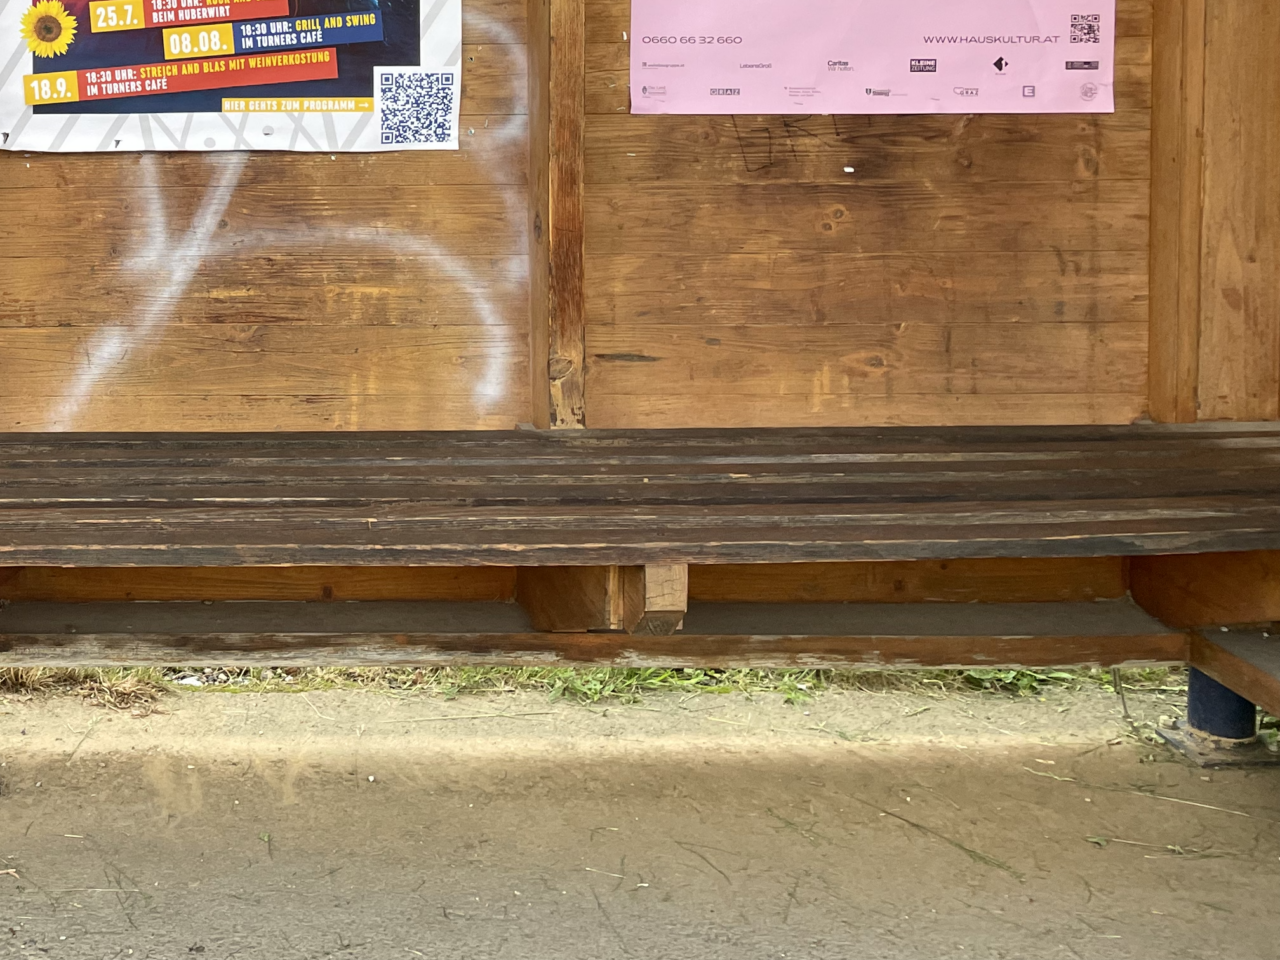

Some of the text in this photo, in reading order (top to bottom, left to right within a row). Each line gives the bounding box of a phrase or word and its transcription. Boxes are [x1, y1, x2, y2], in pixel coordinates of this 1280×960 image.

[96, 4, 138, 28] 25.7.
[170, 30, 227, 55] 08.08.
[642, 36, 743, 44] 0660 66 32 660
[923, 35, 1061, 44] WWW.HAUSKULTUR.AT
[30, 77, 71, 100] 18.9.
[224, 100, 355, 111] HIER GEHTS ZUM PROGRAMM
